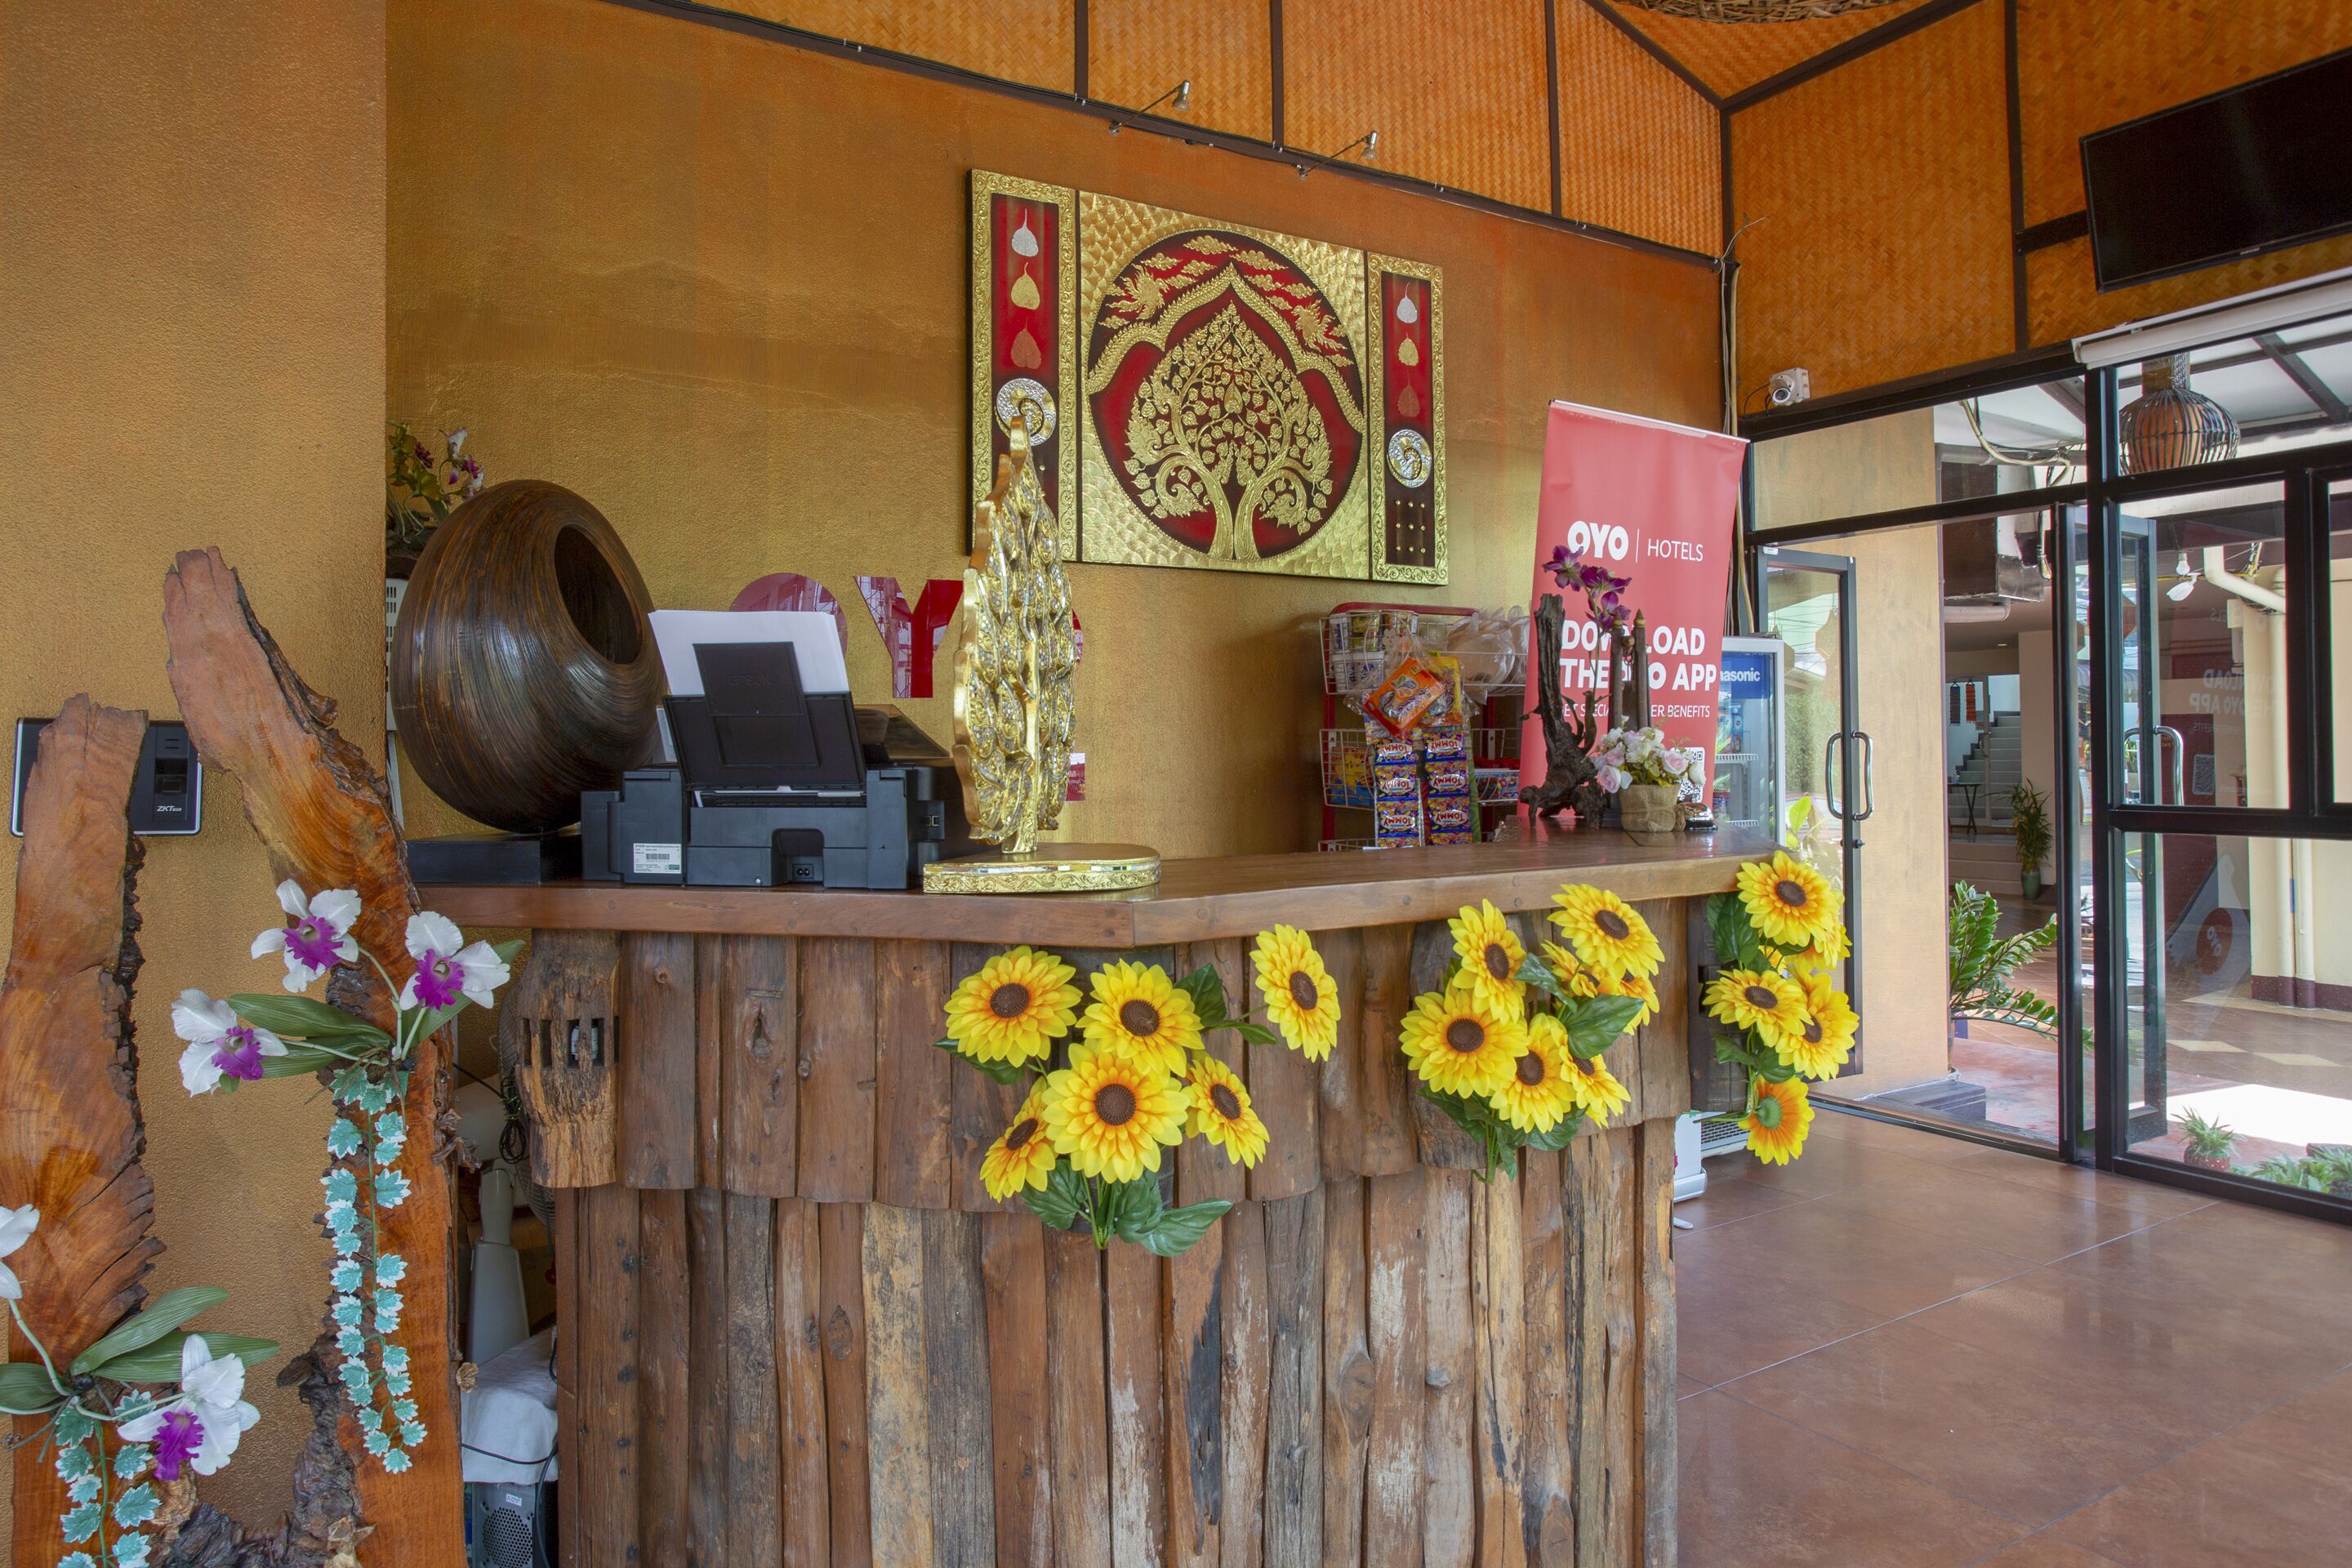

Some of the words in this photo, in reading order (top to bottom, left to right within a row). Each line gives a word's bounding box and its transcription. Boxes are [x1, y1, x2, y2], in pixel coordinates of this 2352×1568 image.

[1567, 520, 1629, 560] OYO
[1647, 538, 1704, 562] HOTELS
[1561, 620, 1705, 656] DOOAD
[1560, 658, 1610, 688] THE
[1672, 663, 1717, 691] APP
[1720, 668, 1761, 682] asonic
[1668, 705, 1710, 718] BENEFITS
[1433, 777, 1463, 787] TOMMY
[1383, 817, 1412, 826] TOMMY
[1436, 813, 1464, 822] TOMMY
